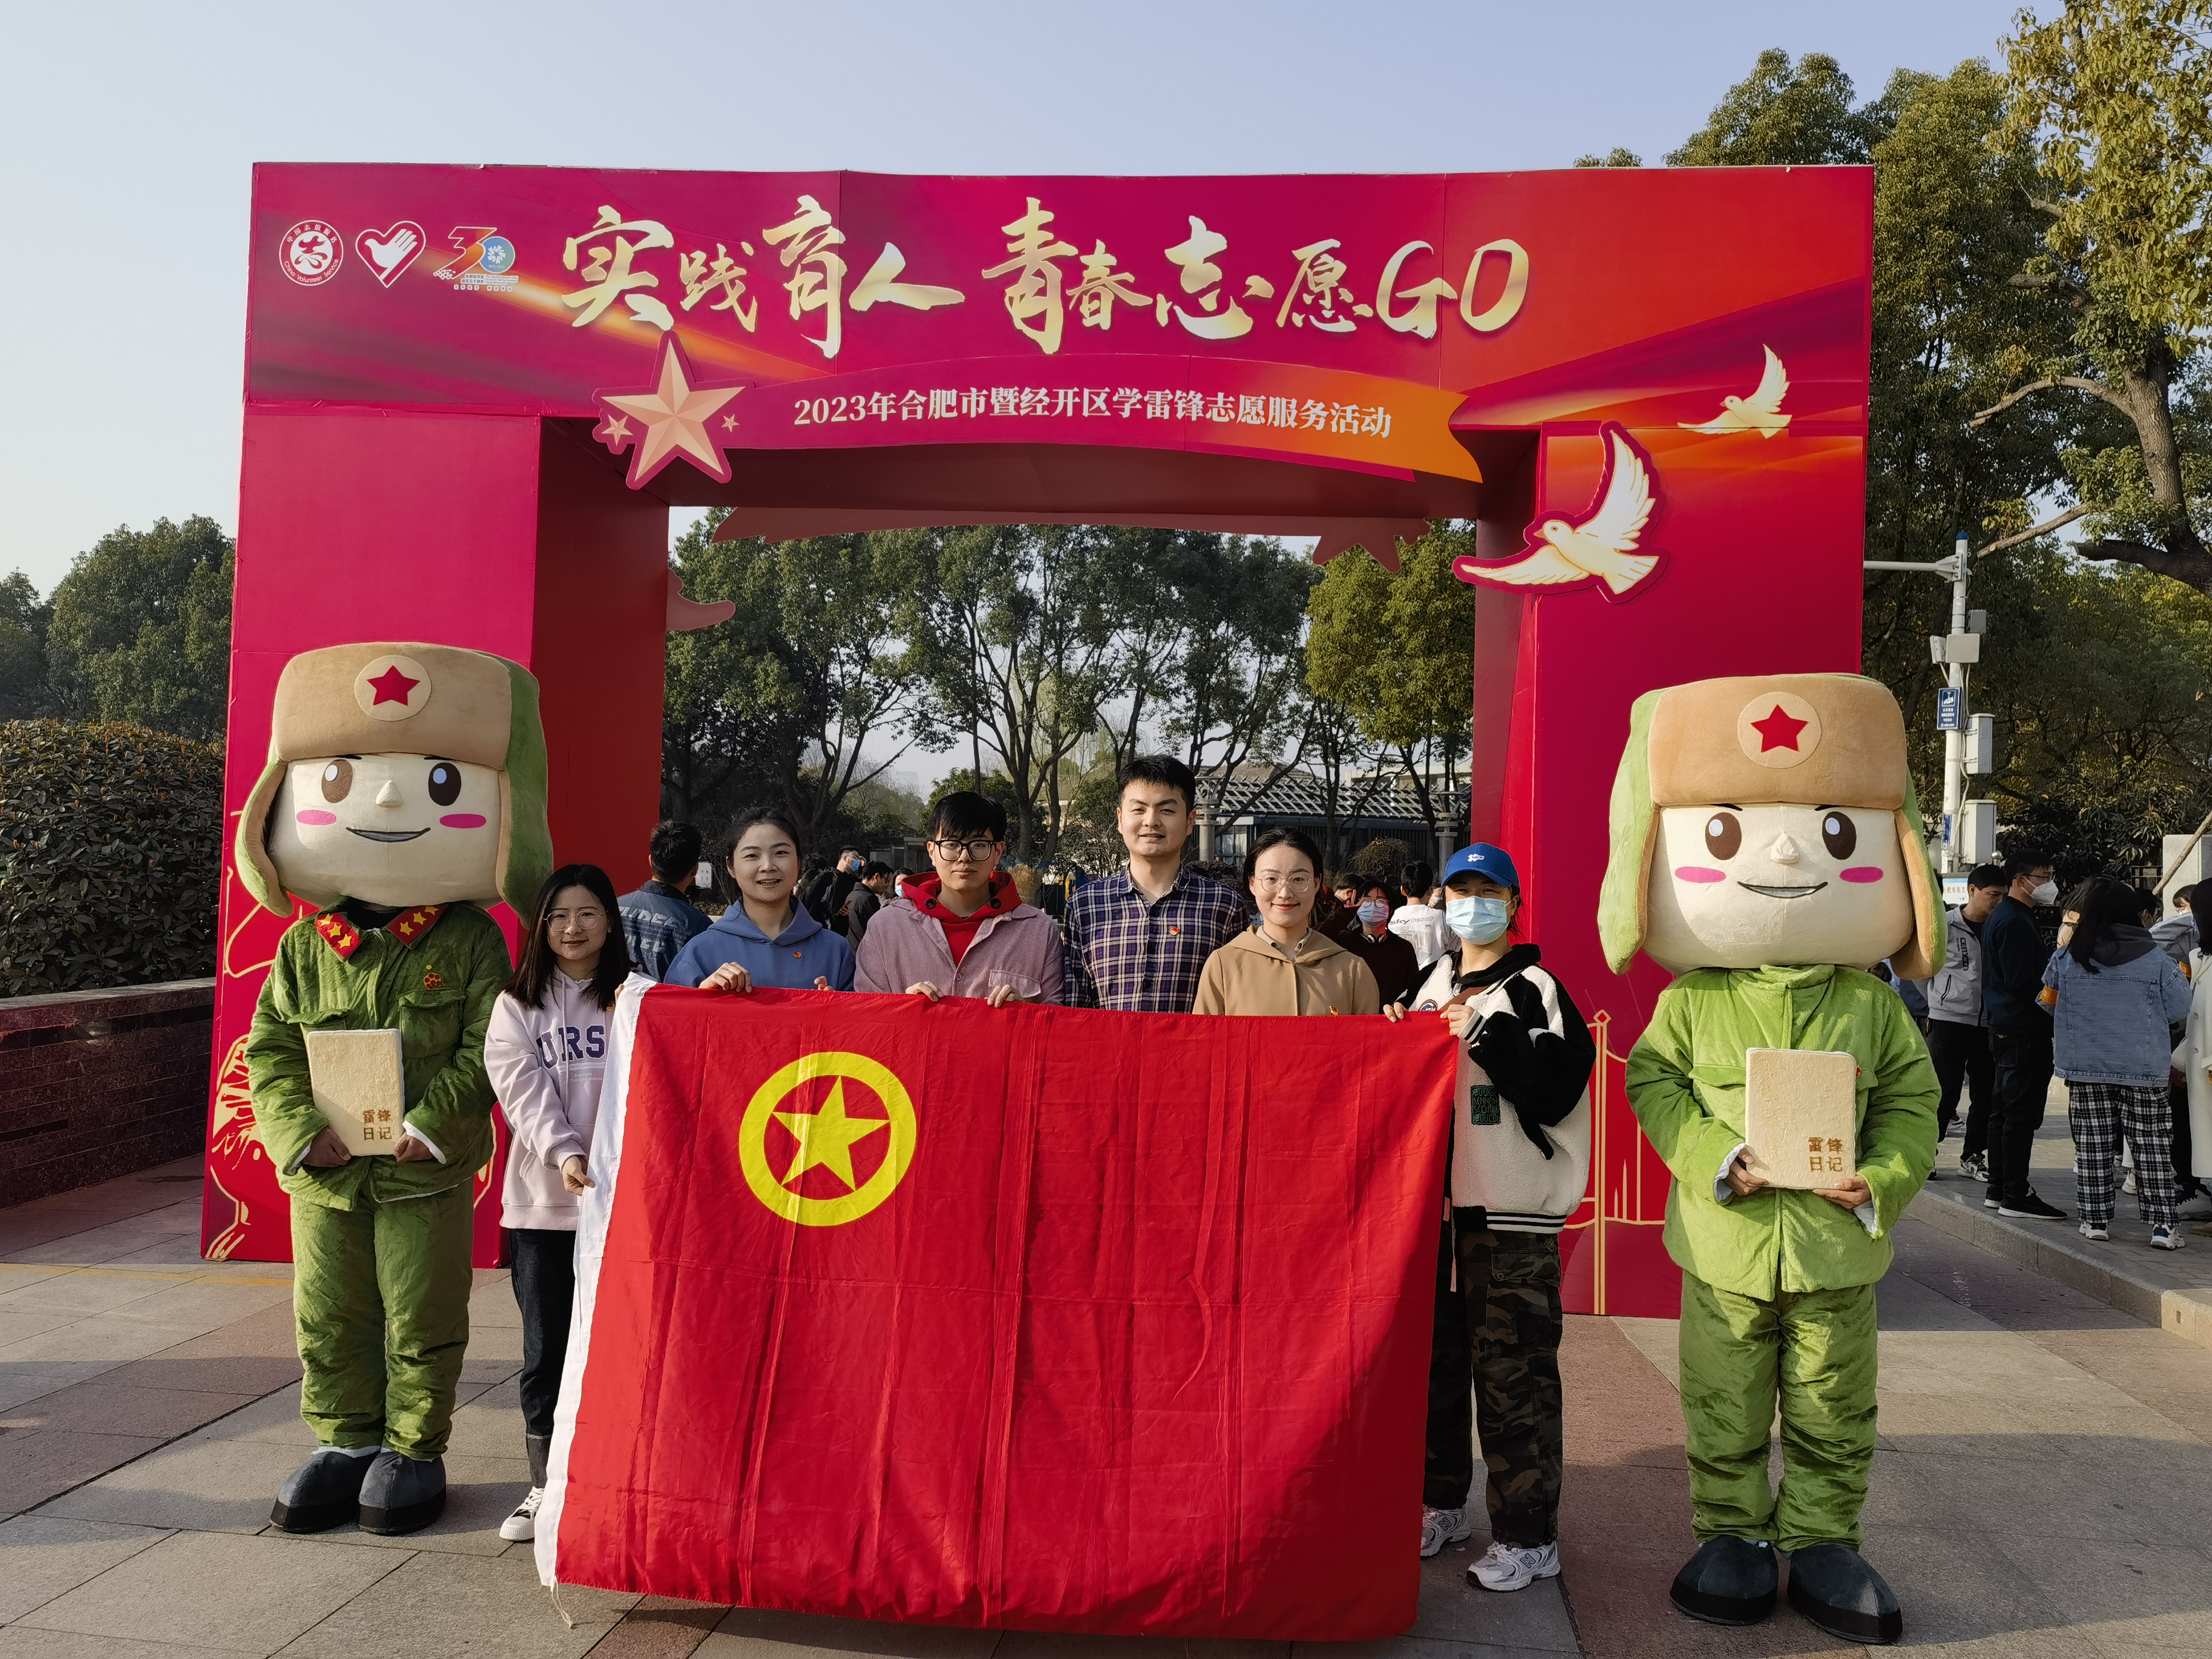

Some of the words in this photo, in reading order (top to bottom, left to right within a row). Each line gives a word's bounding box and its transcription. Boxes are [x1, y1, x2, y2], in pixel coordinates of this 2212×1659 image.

[284, 261, 296, 276] China
[297, 275, 322, 284] Volunteer
[323, 259, 339, 277] Service
[562, 195, 965, 359] 实践育人
[795, 387, 1391, 438] 2023年合肥市暨经开区学雷锋志愿服务活动
[362, 1109, 392, 1125] 雷锋
[363, 1127, 392, 1141] 日记
[1808, 1137, 1844, 1154] 雷锋
[1810, 1156, 1843, 1172] 日记
